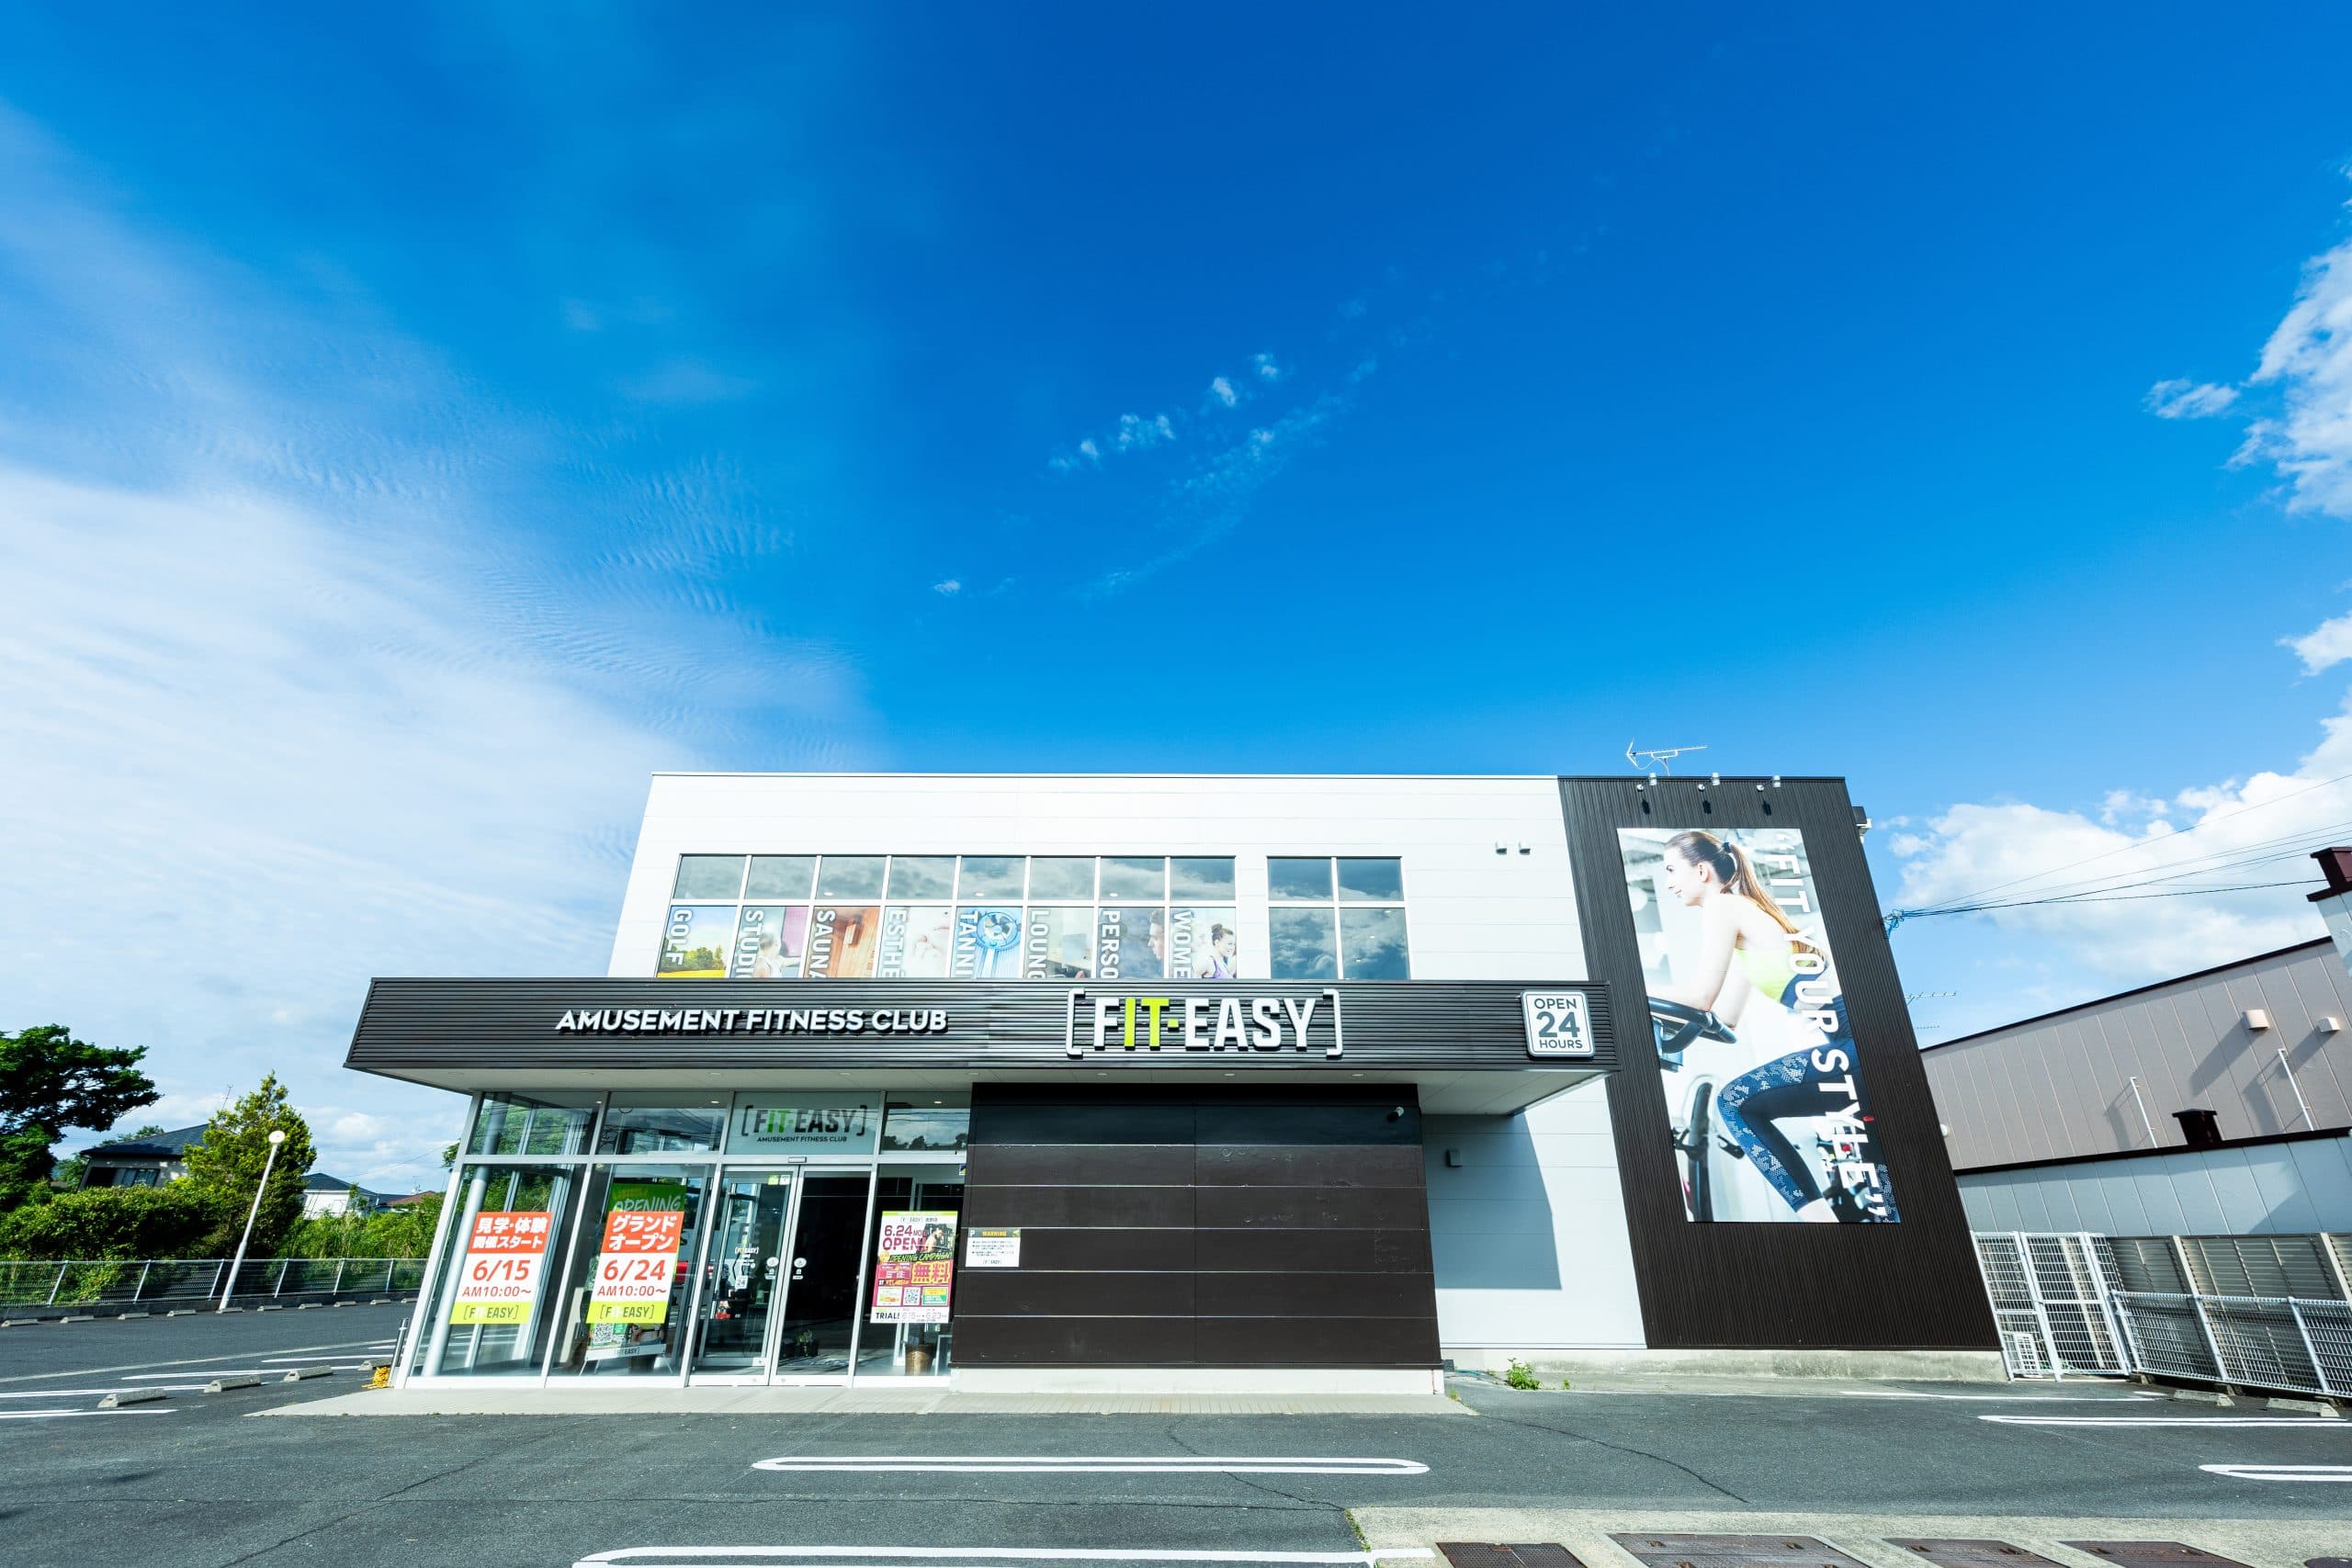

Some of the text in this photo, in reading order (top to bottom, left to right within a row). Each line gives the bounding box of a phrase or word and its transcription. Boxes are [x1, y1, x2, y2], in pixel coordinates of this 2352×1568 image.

[666, 909, 693, 964] GOLF
[1783, 926, 1839, 1043] YOUR
[1533, 998, 1577, 1010] OPEN
[555, 1010, 948, 1032] AMUSEMENT FITNESS CLUB
[1536, 1010, 1580, 1038] 24
[1539, 1039, 1583, 1049] HOURS
[613, 1214, 677, 1233] グランド
[608, 1233, 674, 1250] オープン
[472, 1259, 531, 1281] 6/15
[603, 1258, 666, 1281] 6/24
[876, 1312, 900, 1320] TRIAL!
